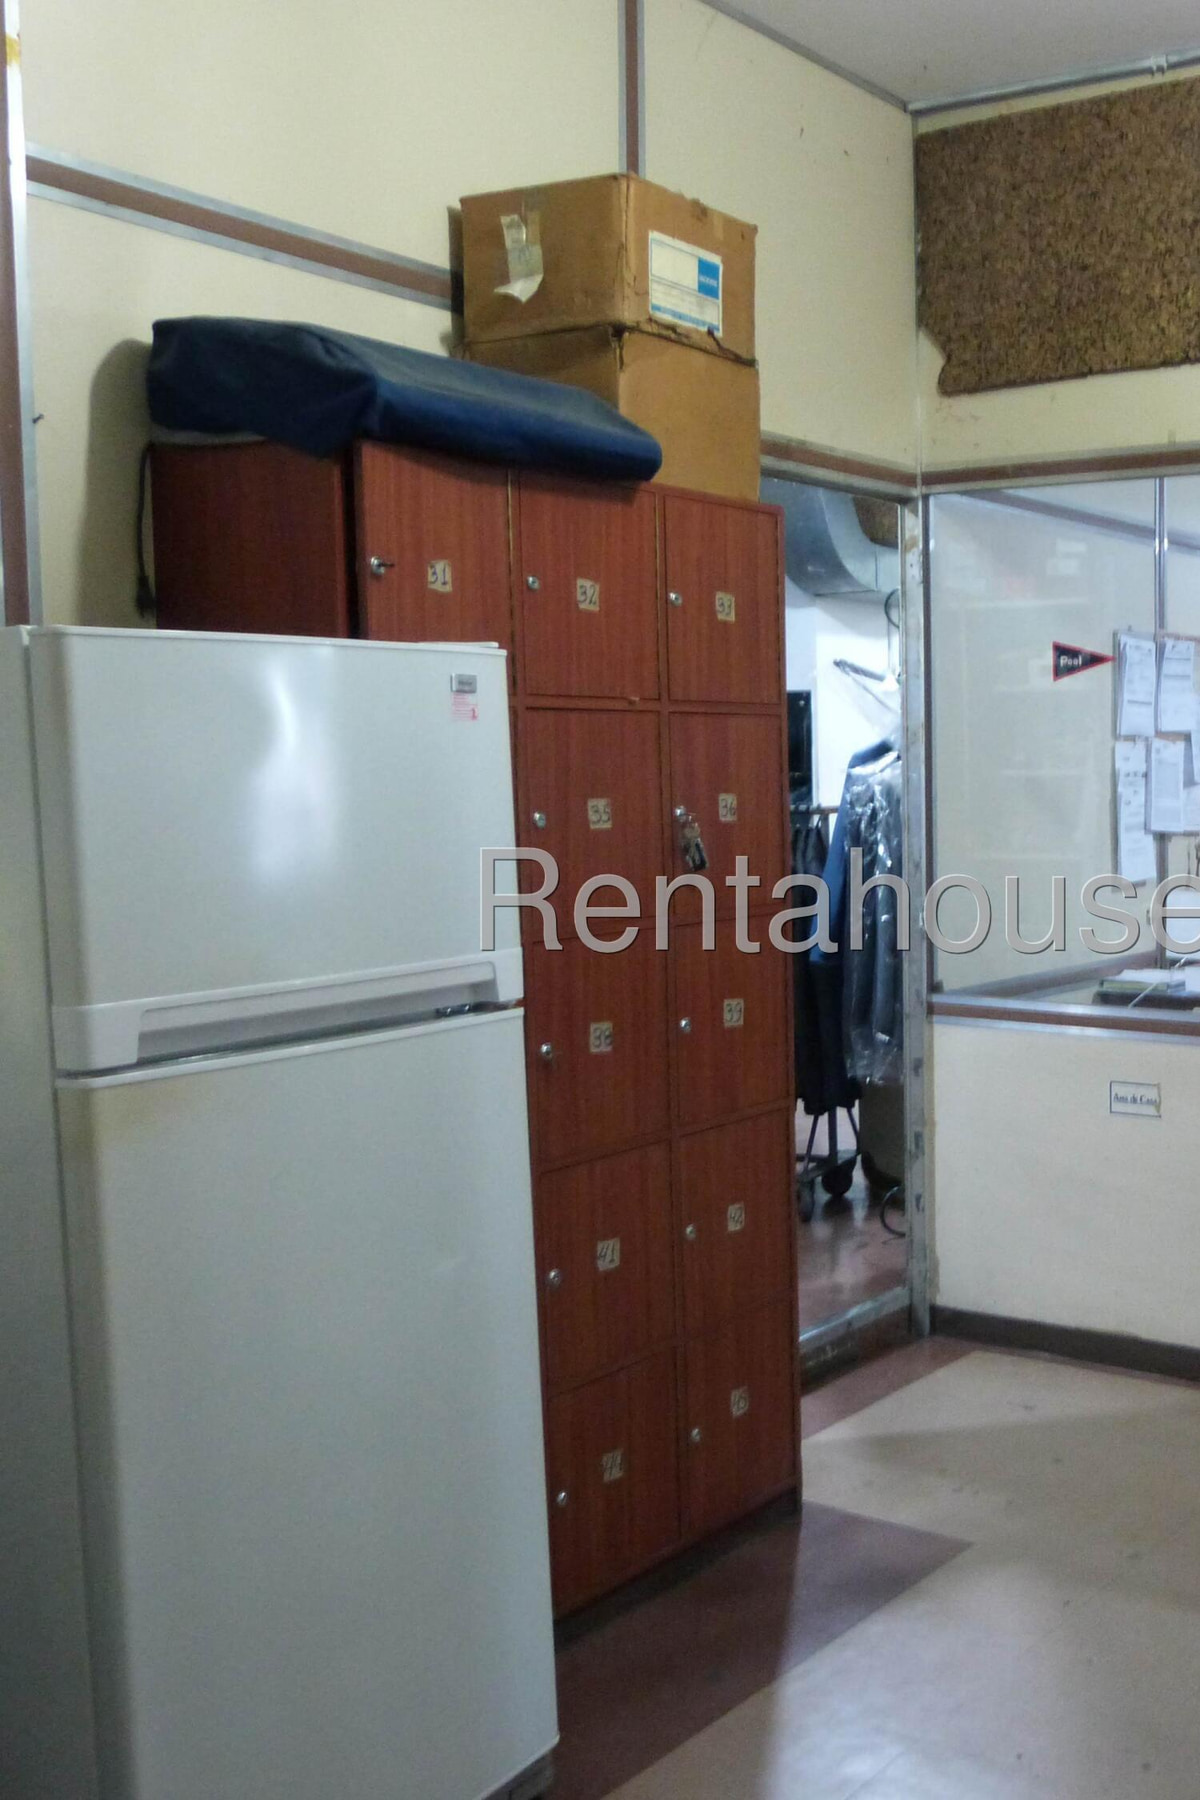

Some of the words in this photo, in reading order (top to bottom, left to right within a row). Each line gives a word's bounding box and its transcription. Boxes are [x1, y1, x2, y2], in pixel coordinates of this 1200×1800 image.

[429, 563, 448, 586] 31
[578, 584, 597, 606] 32
[591, 802, 610, 824] 35
[720, 798, 736, 817] 36
[598, 1242, 616, 1264] 41
